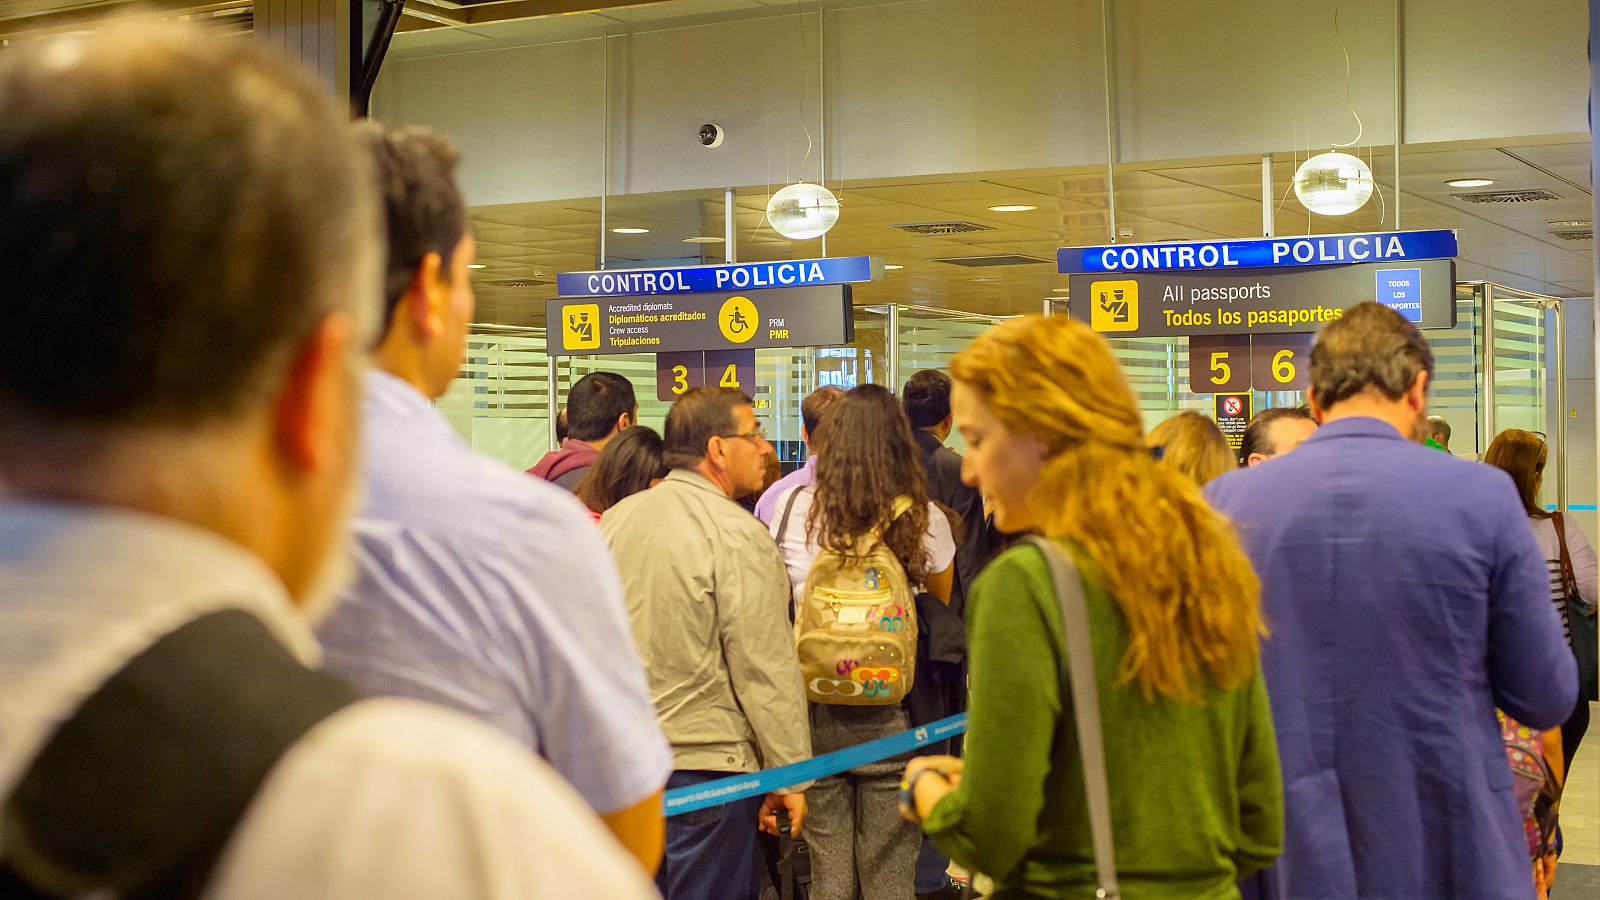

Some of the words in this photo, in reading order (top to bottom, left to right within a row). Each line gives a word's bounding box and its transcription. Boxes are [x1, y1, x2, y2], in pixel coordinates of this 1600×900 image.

[1101, 244, 1239, 270] CONTROL
[1272, 236, 1406, 264] POLICIA
[587, 272, 691, 293] CONTROL
[715, 262, 825, 288] POLICIA
[1163, 285, 1184, 302] All
[1191, 283, 1271, 304] passports
[1393, 291, 1406, 299] LOS
[608, 304, 641, 313] Accredited
[642, 302, 673, 311] diplomats
[1384, 302, 1420, 310] SAPORTES
[609, 314, 658, 325] Diplomáticos
[660, 311, 706, 321] acreditados
[769, 318, 785, 328] PRM
[1163, 309, 1212, 326] Todos
[1217, 308, 1242, 324] los
[1247, 305, 1343, 328] pasaportes
[609, 326, 625, 335] Crew
[626, 326, 649, 334] access
[769, 329, 789, 340] PMR
[609, 336, 660, 347] Tripulaciones
[1209, 351, 1231, 385] 5
[1271, 349, 1296, 383] 6
[671, 366, 688, 394] 3
[719, 364, 739, 388] 4
